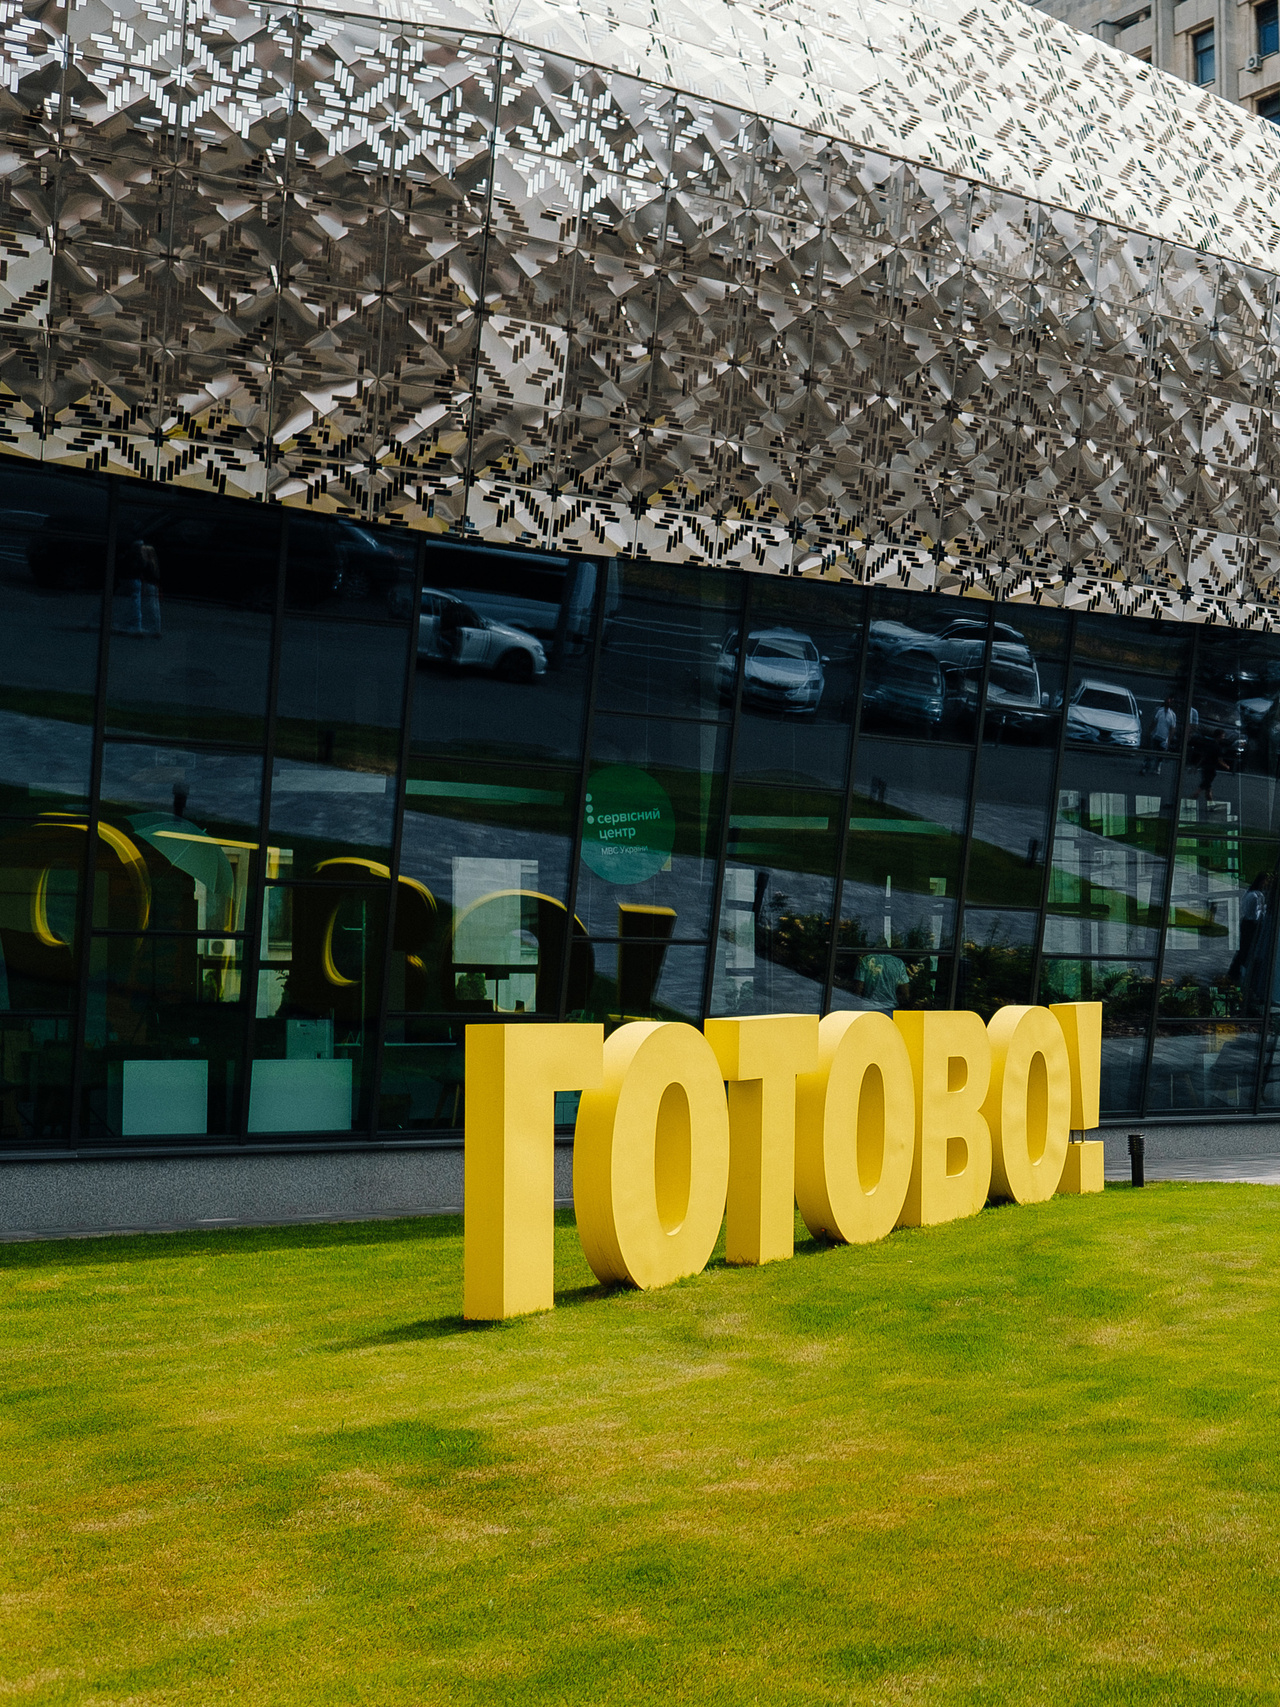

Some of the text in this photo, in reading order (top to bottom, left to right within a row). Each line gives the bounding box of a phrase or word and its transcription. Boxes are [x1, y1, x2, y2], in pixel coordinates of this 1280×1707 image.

[597, 807, 660, 825] сервісний
[599, 827, 636, 840] центр
[601, 846, 648, 856] МВС України
[464, 1002, 1105, 1321] ГОТОВО!
